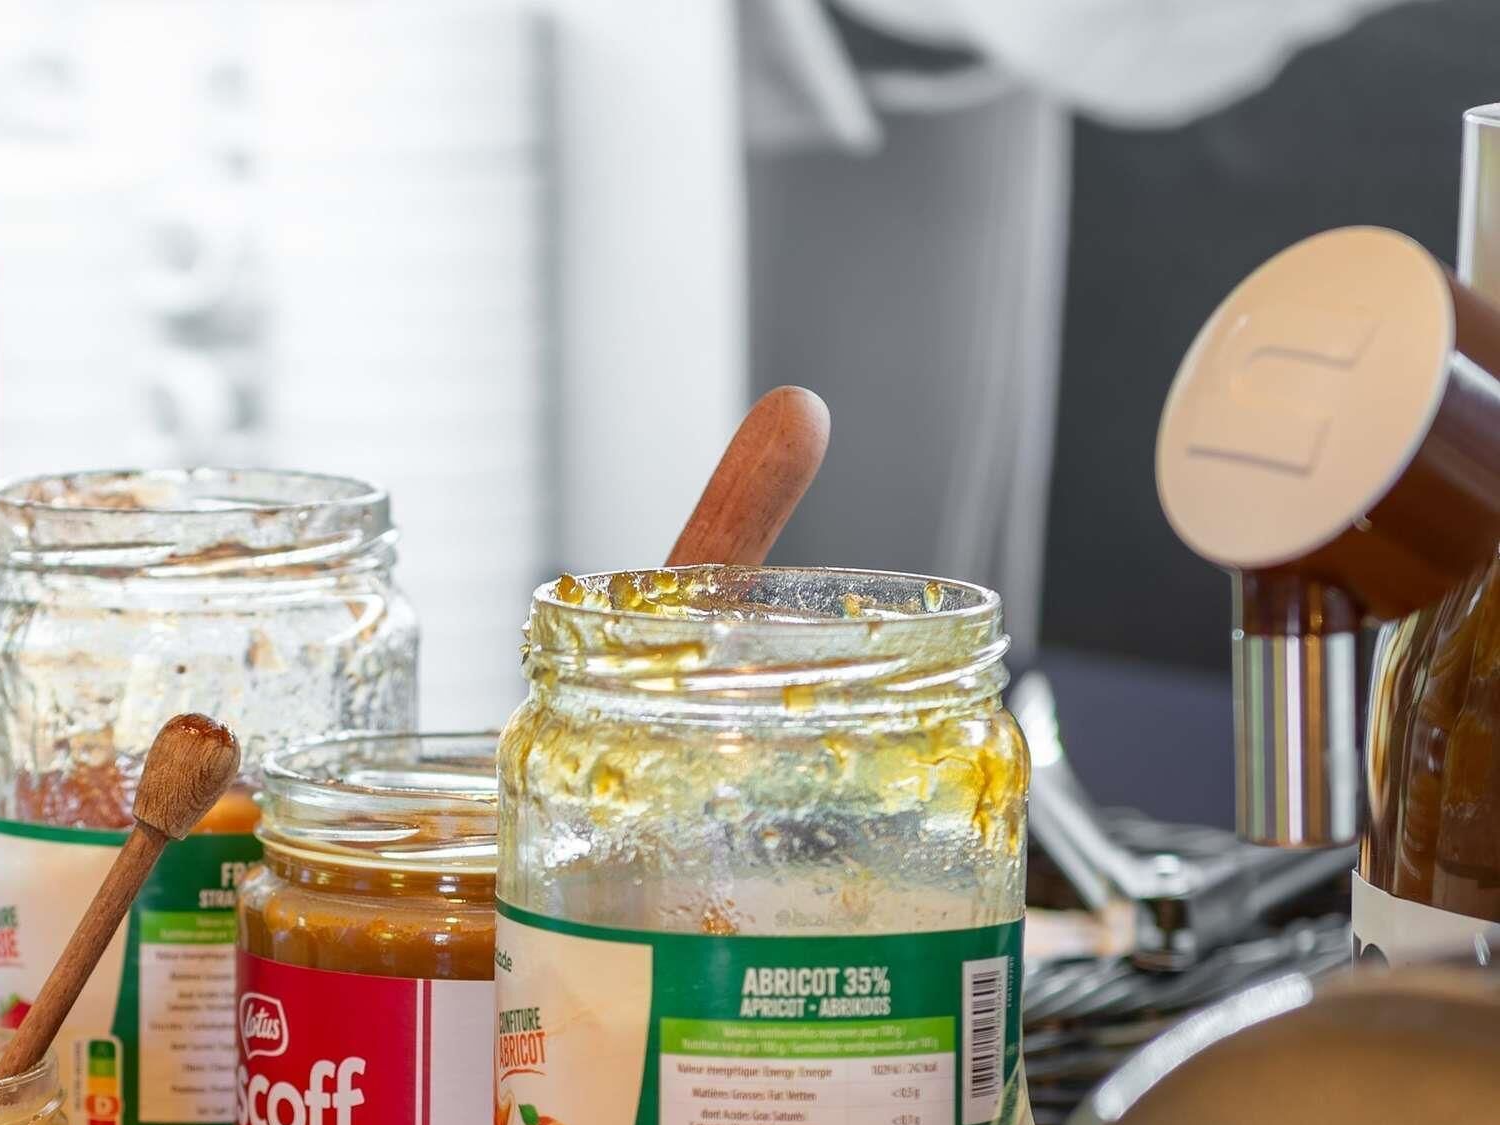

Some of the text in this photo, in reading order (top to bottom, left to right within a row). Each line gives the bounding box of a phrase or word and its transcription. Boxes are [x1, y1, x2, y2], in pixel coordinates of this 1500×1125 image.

[221, 862, 245, 888] FR
[199, 889, 236, 908] STRA
[741, 966, 891, 997] ABRICOT 35%
[739, 998, 806, 1018] APRICOT
